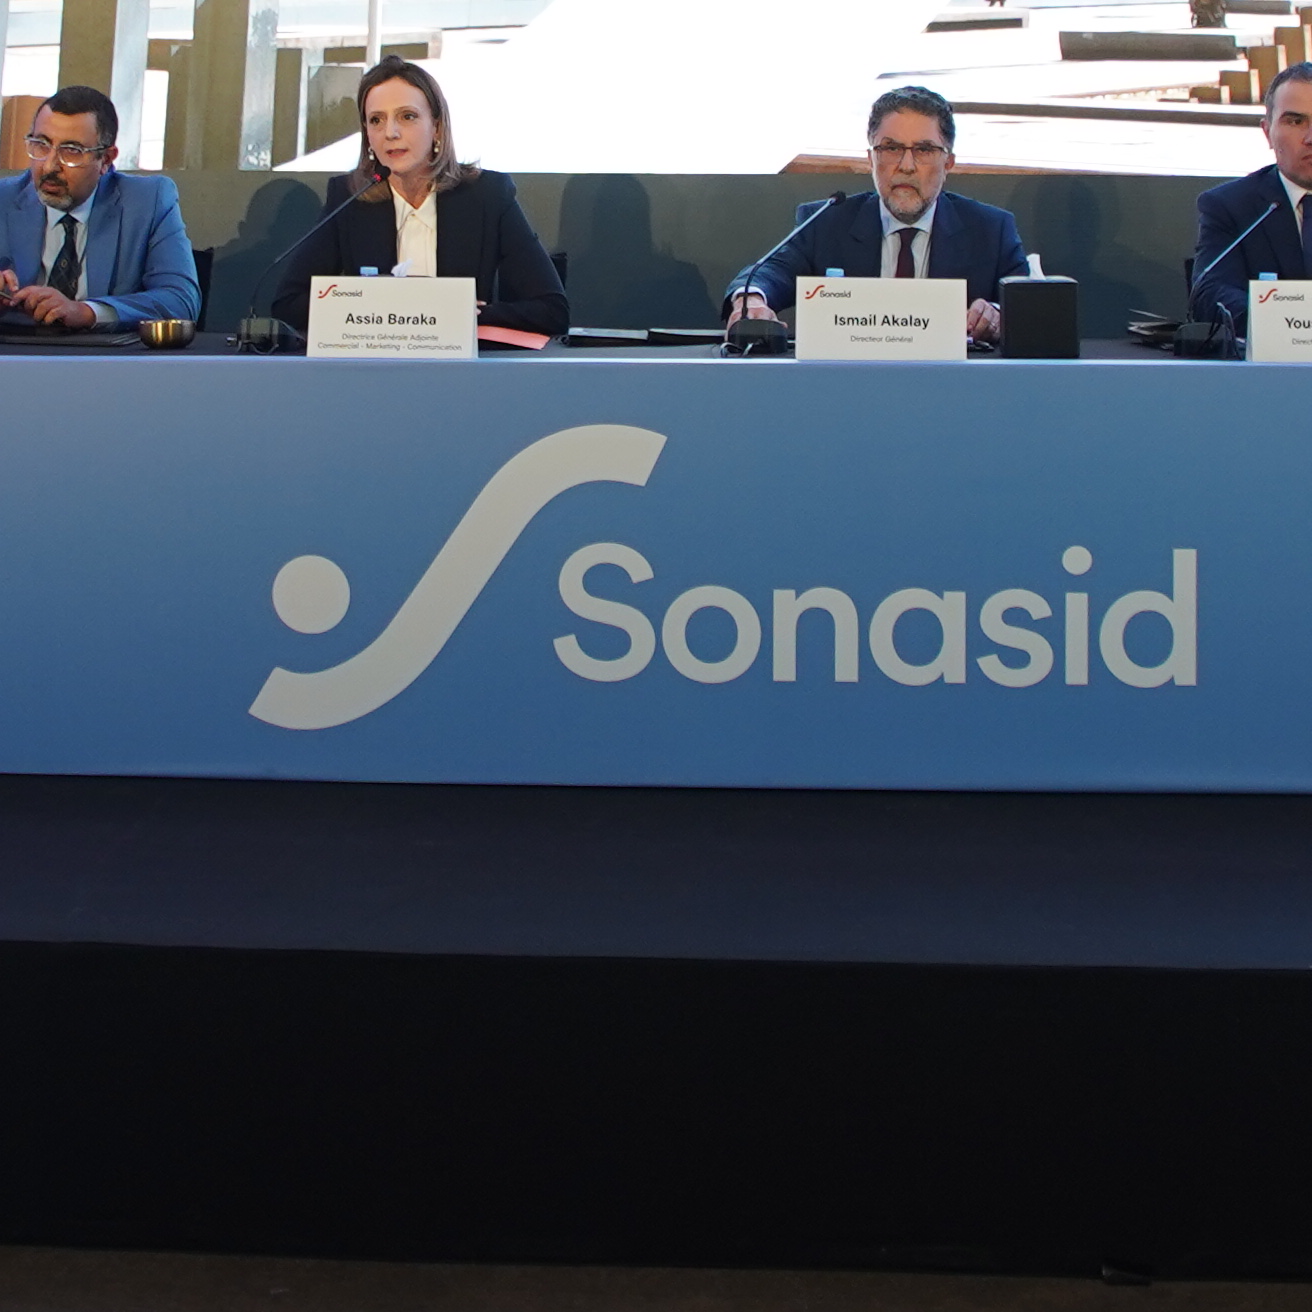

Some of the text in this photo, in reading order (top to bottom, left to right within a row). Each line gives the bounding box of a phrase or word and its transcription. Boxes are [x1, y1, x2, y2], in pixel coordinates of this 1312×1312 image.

[346, 313, 436, 325] Assia Baraka
[835, 315, 929, 330] Ismail Akalay
[552, 544, 1198, 689] Sonasid
